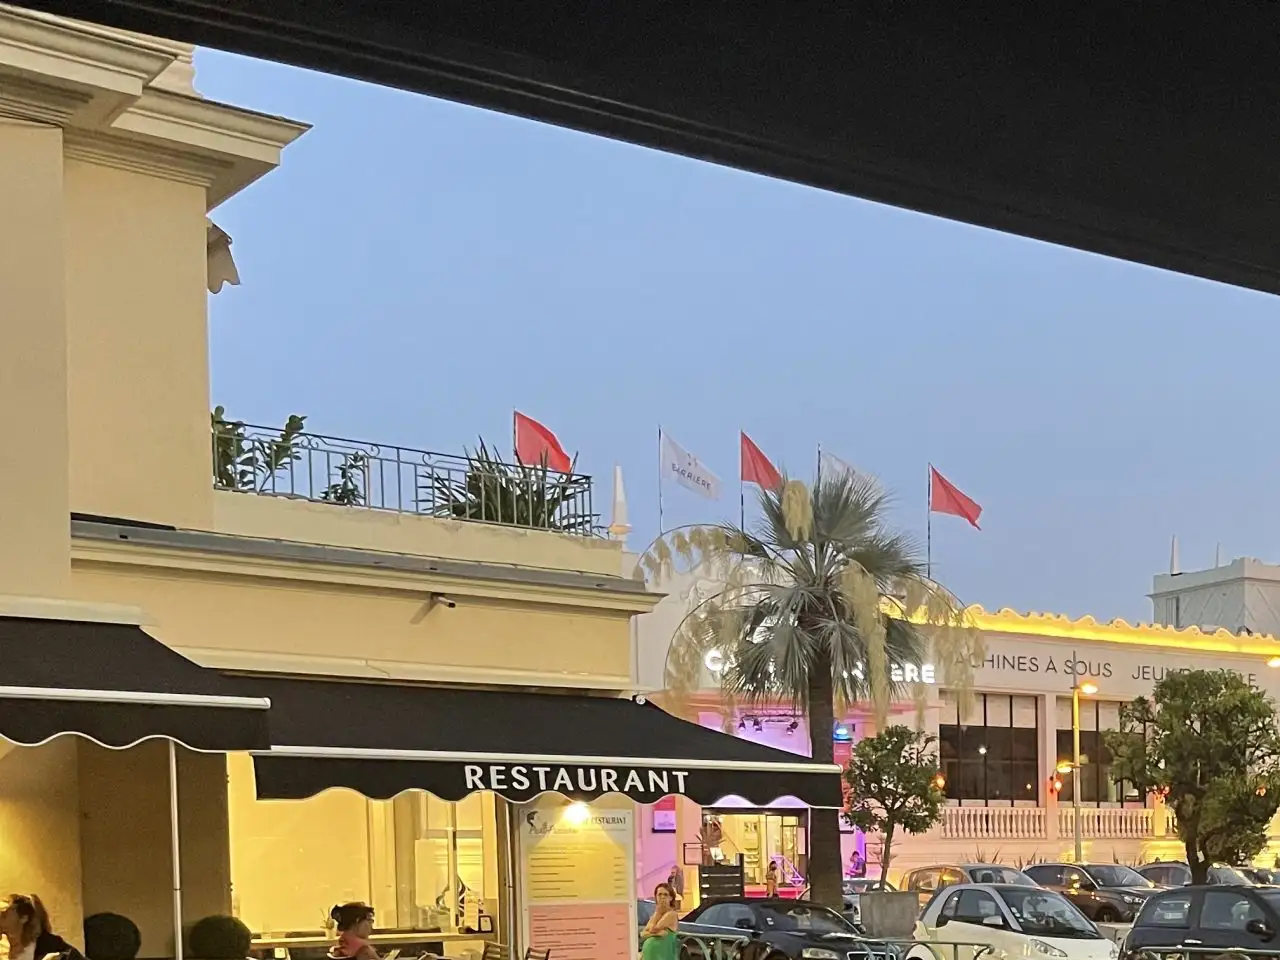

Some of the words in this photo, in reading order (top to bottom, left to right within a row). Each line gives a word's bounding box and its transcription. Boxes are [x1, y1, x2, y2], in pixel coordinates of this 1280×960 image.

[954, 651, 1039, 673] ACHINES
[1045, 654, 1058, 674] À
[1063, 658, 1113, 679] SOUS
[464, 764, 689, 794] RESTAURANT
